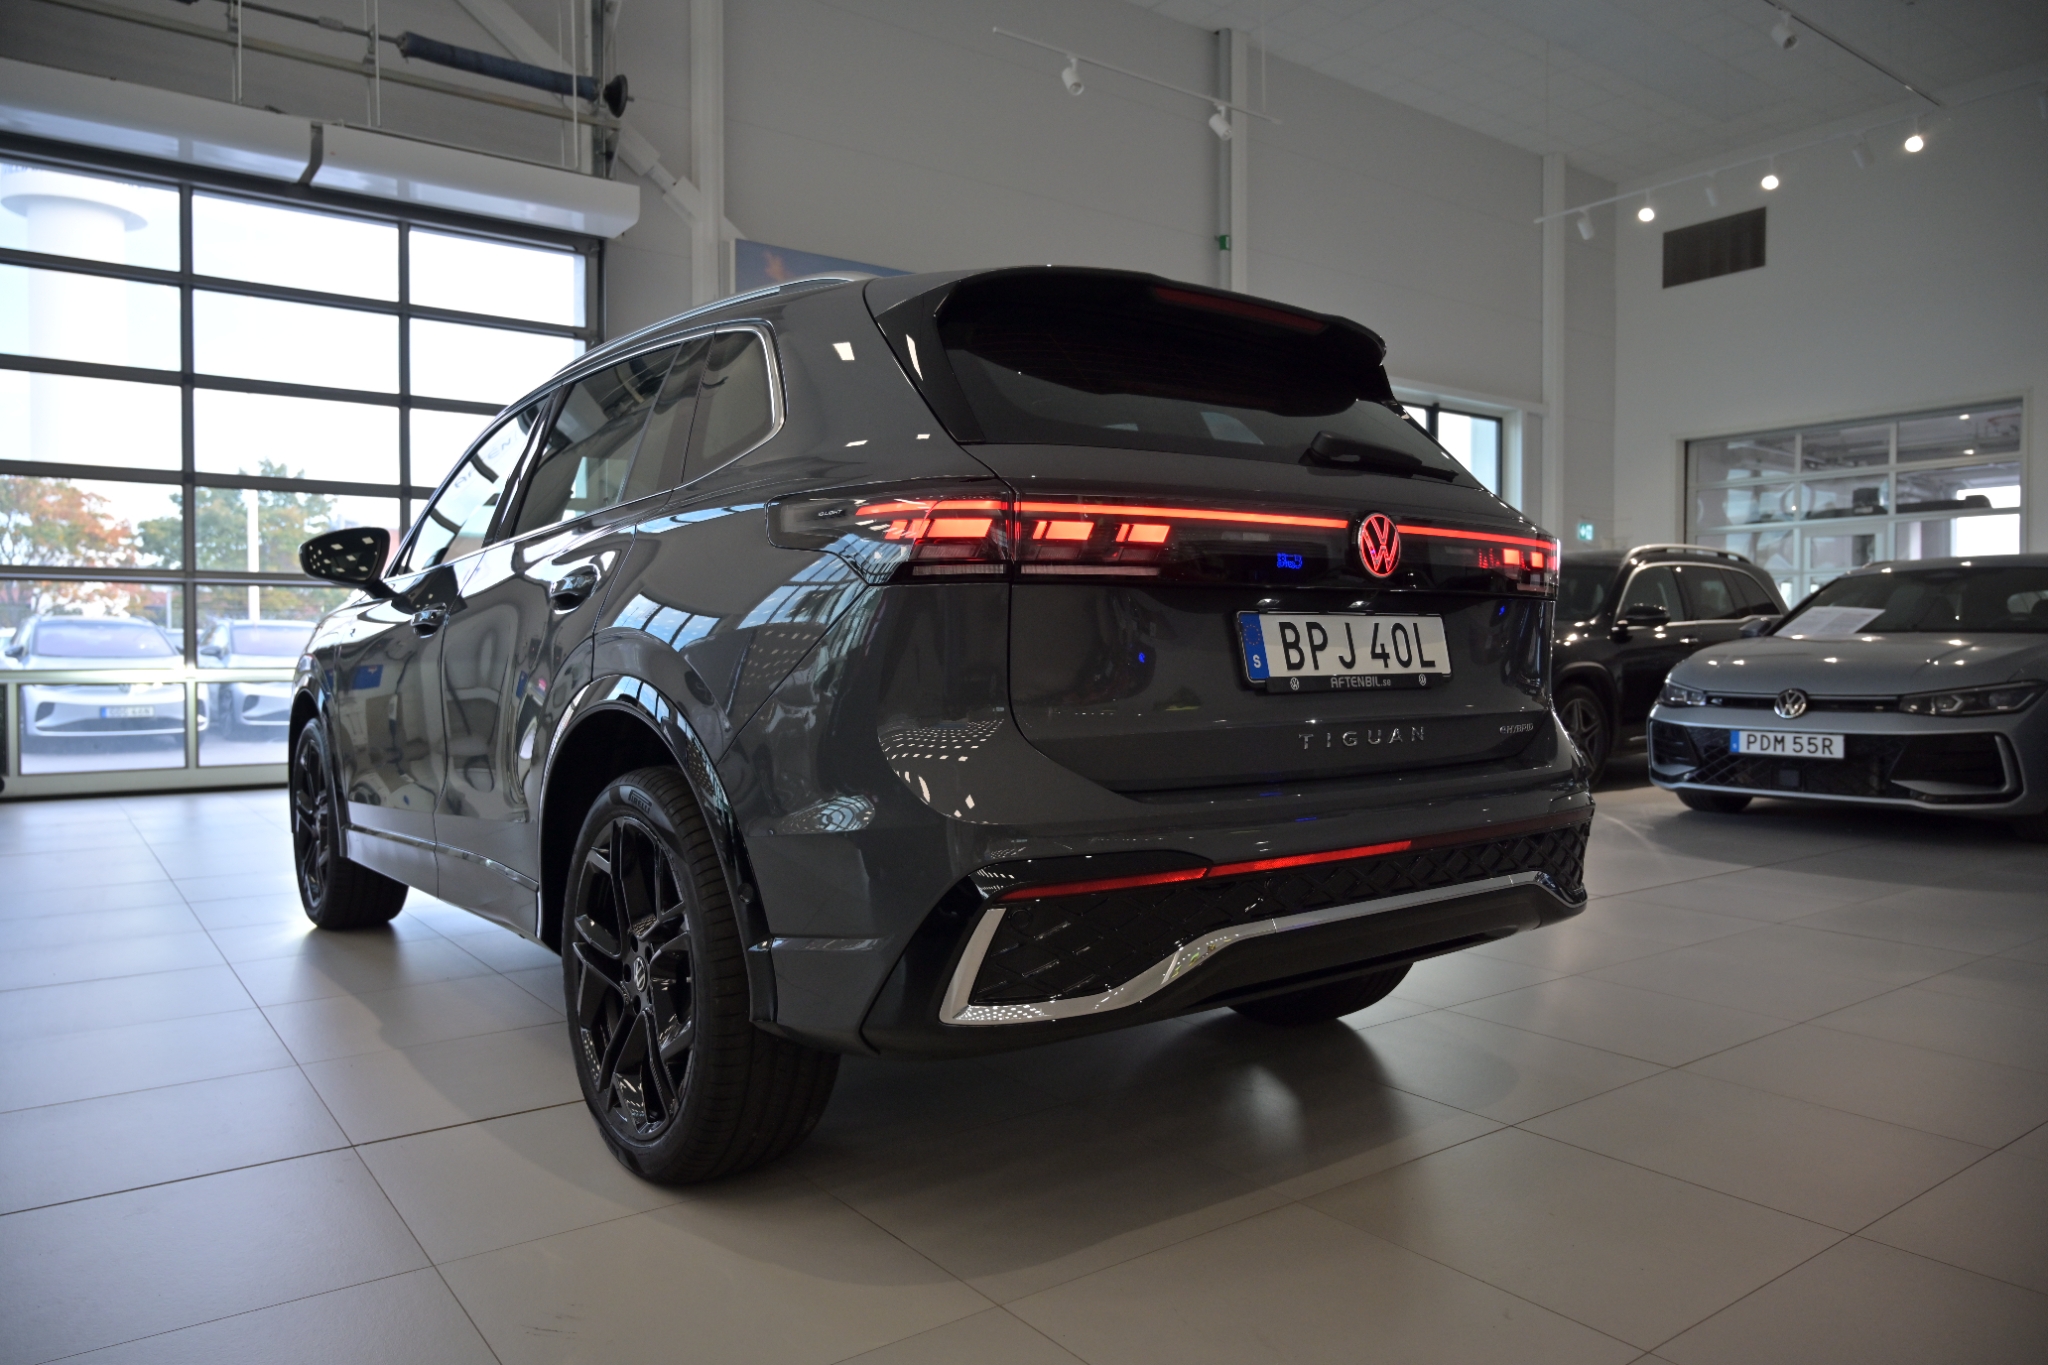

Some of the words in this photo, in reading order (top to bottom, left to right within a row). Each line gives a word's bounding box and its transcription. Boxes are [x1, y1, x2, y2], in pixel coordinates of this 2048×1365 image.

[1358, 513, 1401, 577] VW
[1278, 621, 1356, 670] BPJ
[1370, 622, 1436, 669] 40L
[1252, 654, 1262, 669] S
[1330, 676, 1391, 688] AFTENBIL.se
[1299, 726, 1424, 750] TIGUAN
[1746, 733, 1785, 752] PDM
[1792, 736, 1834, 755] 55R
[628, 789, 652, 814] PIRELLI
